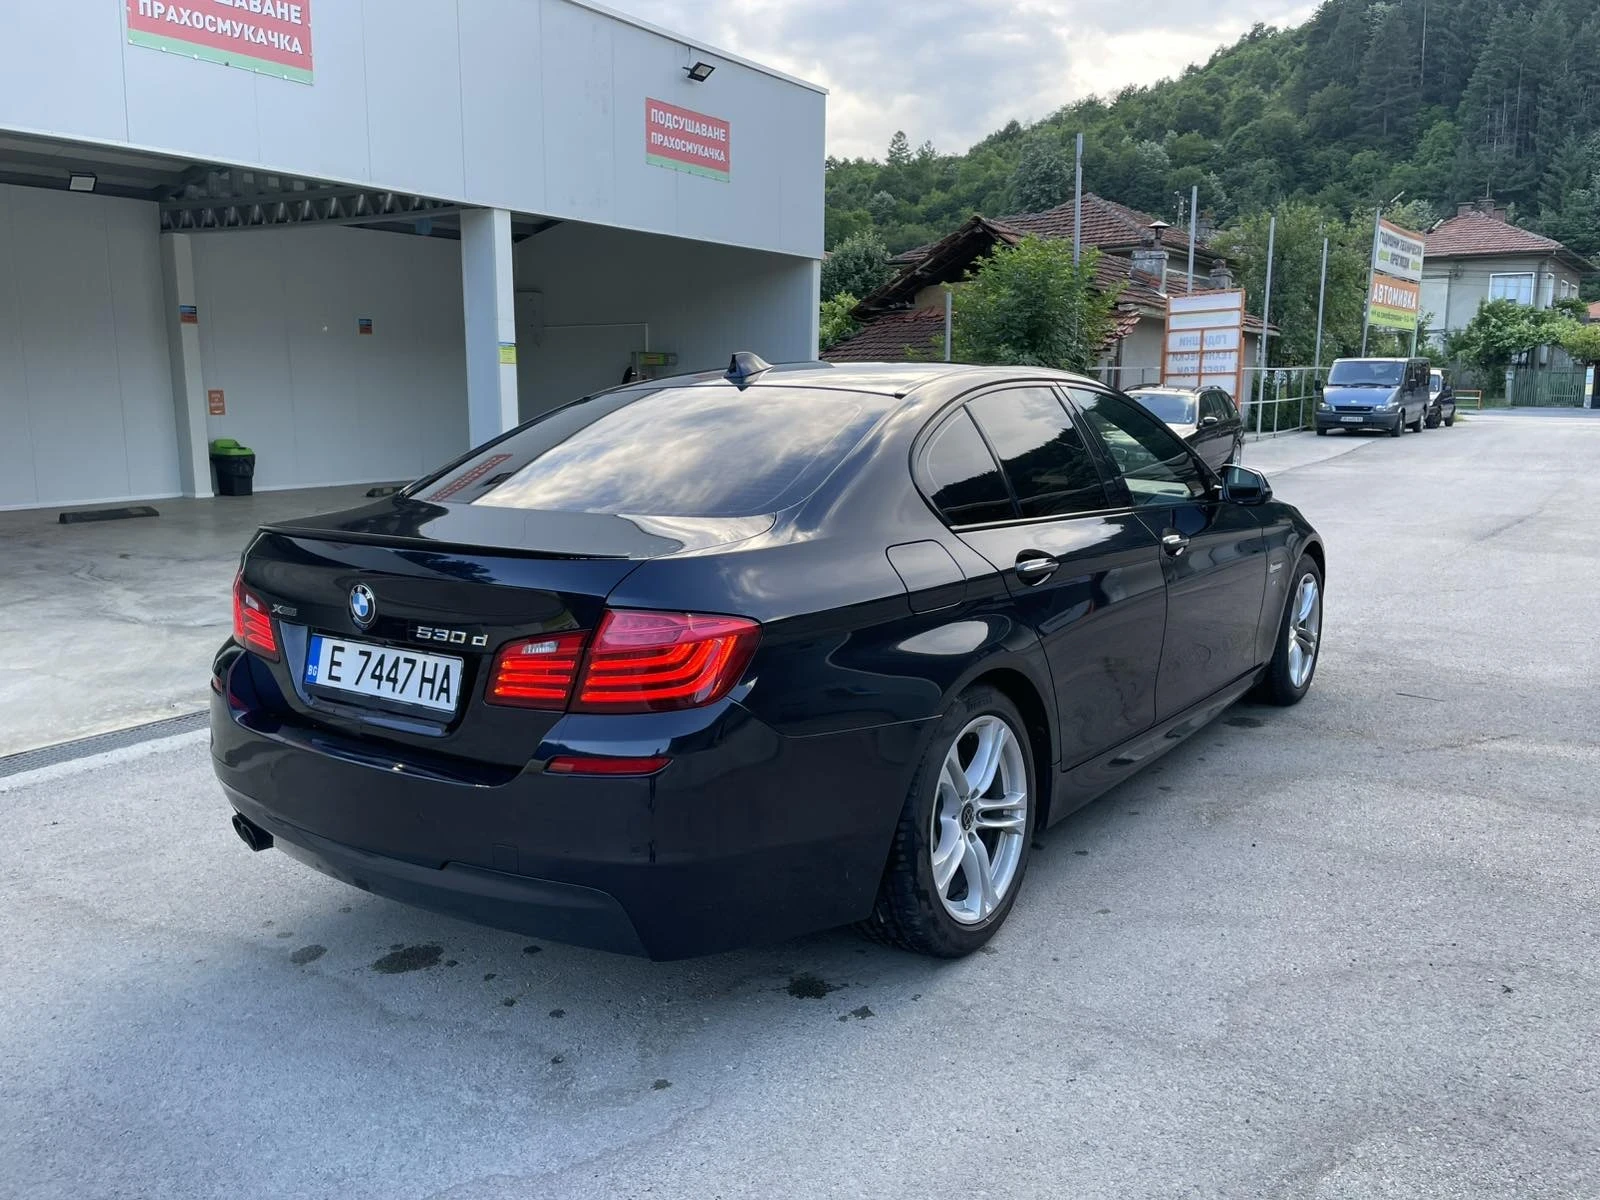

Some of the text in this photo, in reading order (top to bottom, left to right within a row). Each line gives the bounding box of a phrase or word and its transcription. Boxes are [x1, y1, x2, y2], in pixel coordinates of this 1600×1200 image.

[138, 0, 303, 55] ПРАХОСМУКАЧКА
[651, 108, 726, 142] ПОДСУШАВАНЕ
[651, 132, 726, 162] ПРАХОСМУКАЧКА
[1372, 283, 1416, 310] АВТОМИВКА
[416, 626, 489, 646] 530 d
[307, 665, 318, 677] BG
[327, 645, 345, 682] E
[354, 650, 417, 694] 7447
